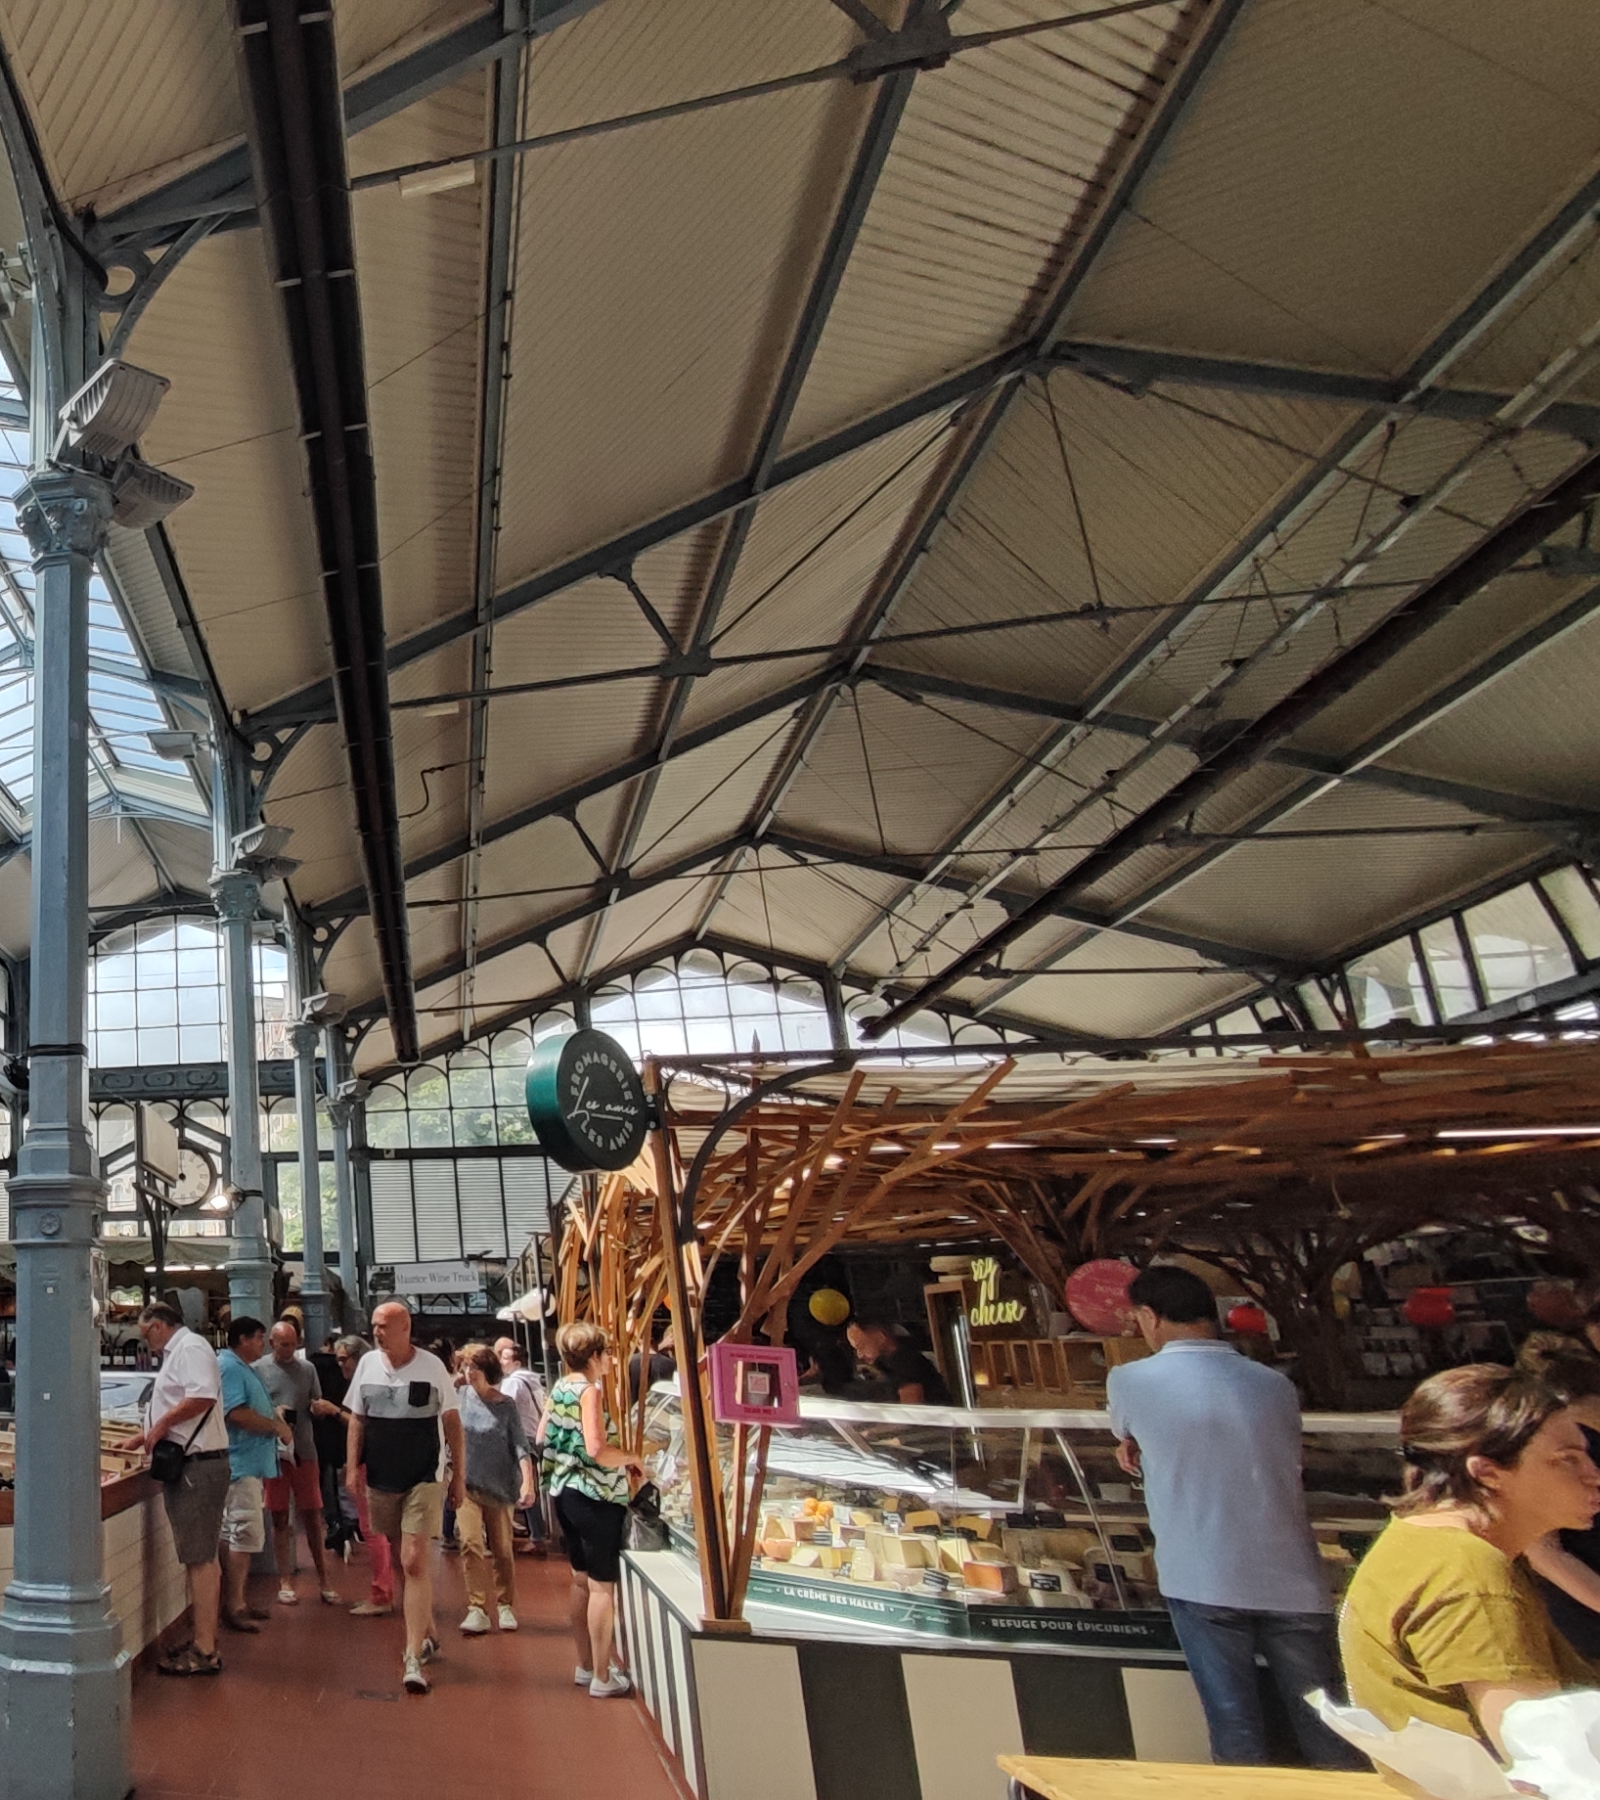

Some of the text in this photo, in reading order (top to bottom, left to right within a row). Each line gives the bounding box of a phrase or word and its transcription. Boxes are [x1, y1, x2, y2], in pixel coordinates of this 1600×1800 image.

[570, 1051, 633, 1100] FROMAGERIE
[567, 1076, 638, 1121] Les amis
[581, 1120, 633, 1151] LES AMIS
[397, 1271, 477, 1285] Maurice Wine Truck
[971, 1257, 998, 1300] say
[971, 1280, 1027, 1326] cheese
[783, 1585, 886, 1613] LA CRÈME DES HALLES
[990, 1618, 1149, 1636] REFUGE POUR ÉPICURIENS
